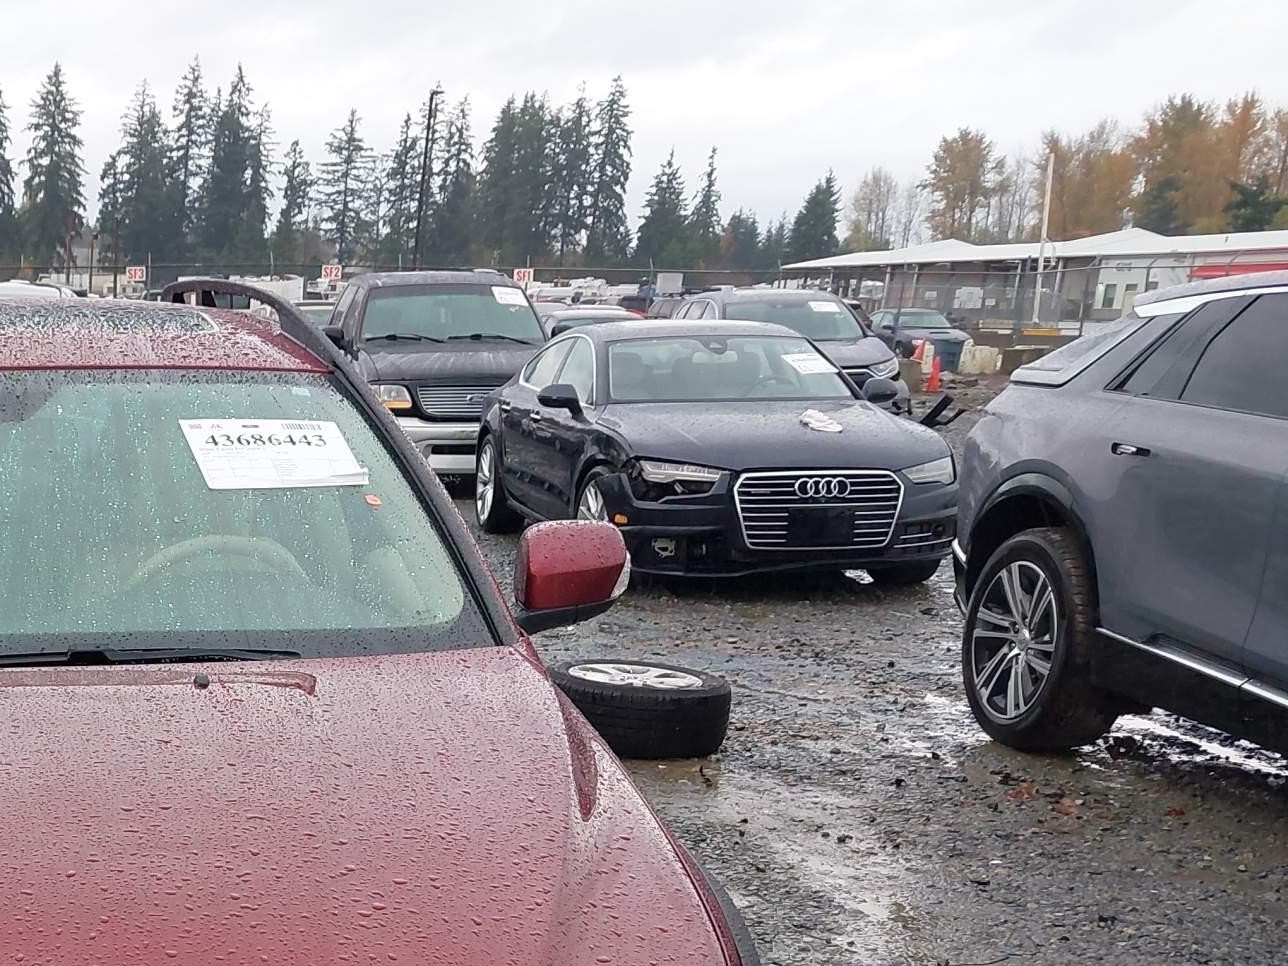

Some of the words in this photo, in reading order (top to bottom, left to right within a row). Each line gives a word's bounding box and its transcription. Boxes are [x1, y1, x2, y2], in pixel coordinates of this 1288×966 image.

[127, 268, 145, 279] SF3
[323, 265, 341, 277] SF2
[516, 270, 531, 281] SF1
[205, 434, 327, 447] 43686443
